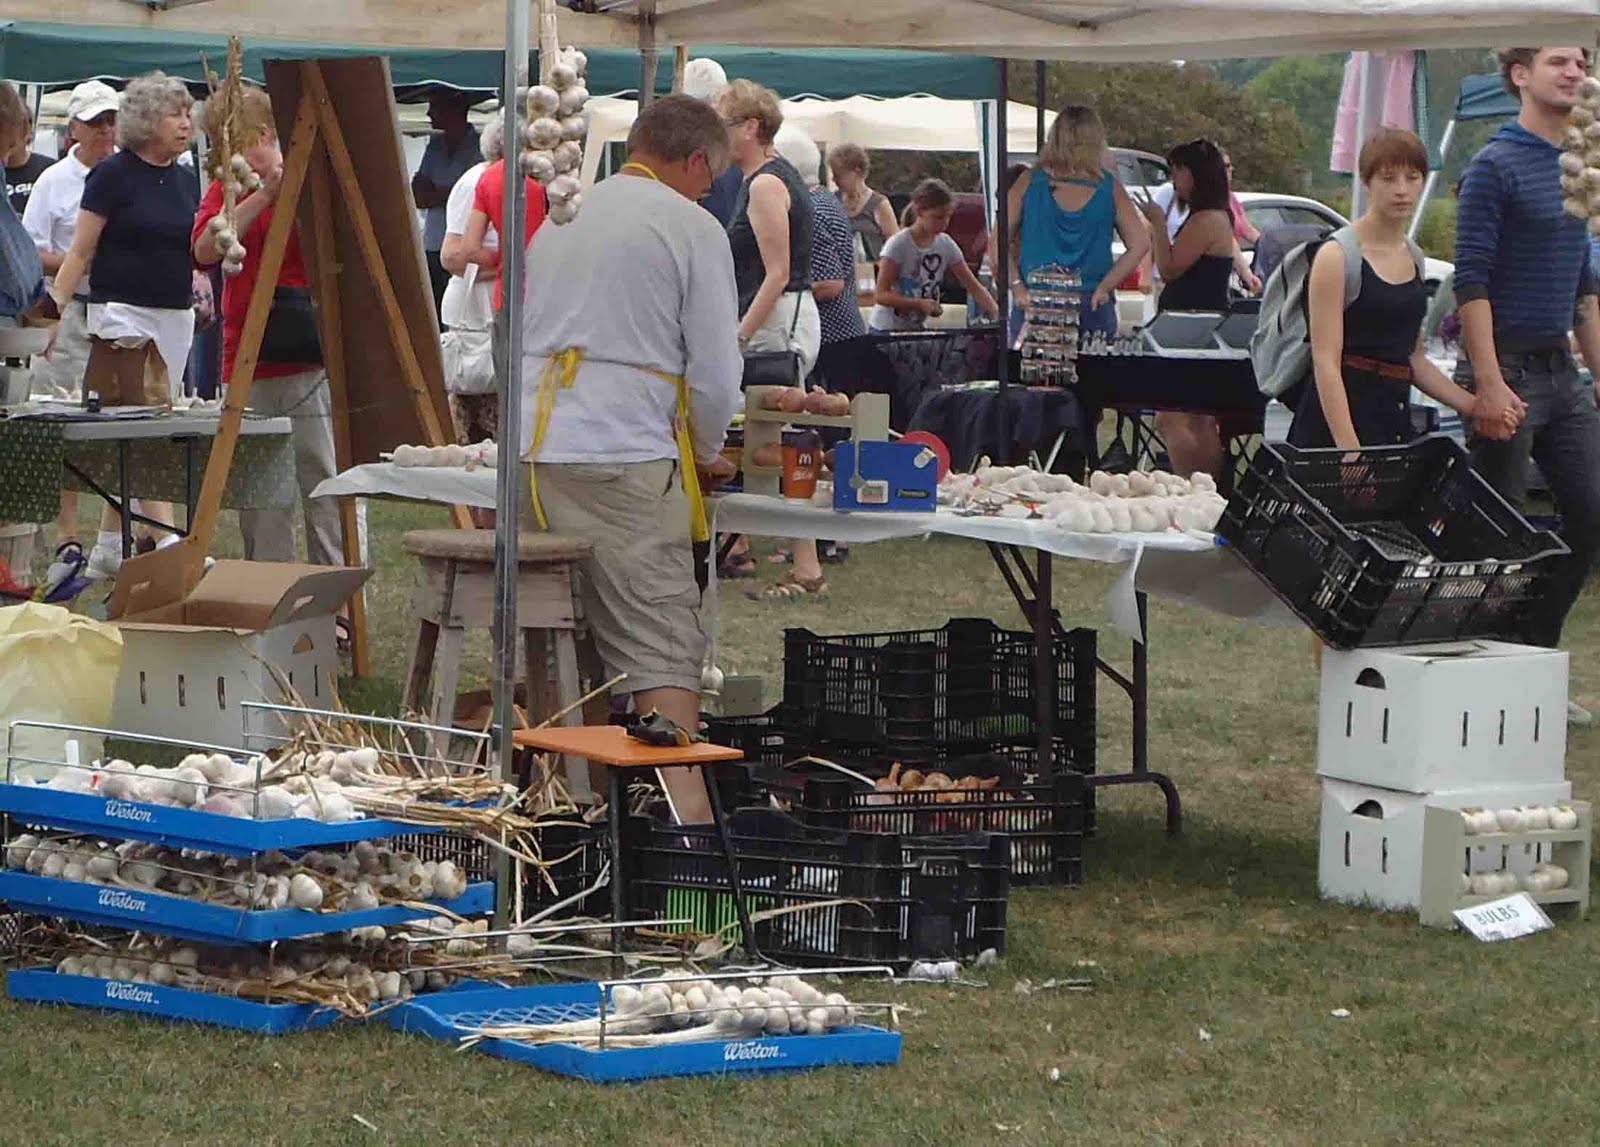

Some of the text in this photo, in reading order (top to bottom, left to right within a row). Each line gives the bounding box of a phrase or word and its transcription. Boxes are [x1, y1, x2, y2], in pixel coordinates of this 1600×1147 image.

[105, 800, 152, 823] Weston
[98, 889, 146, 912] Weston
[1473, 904, 1520, 925] BULBS
[105, 981, 153, 1004] Weston
[723, 1042, 779, 1061] Weston
